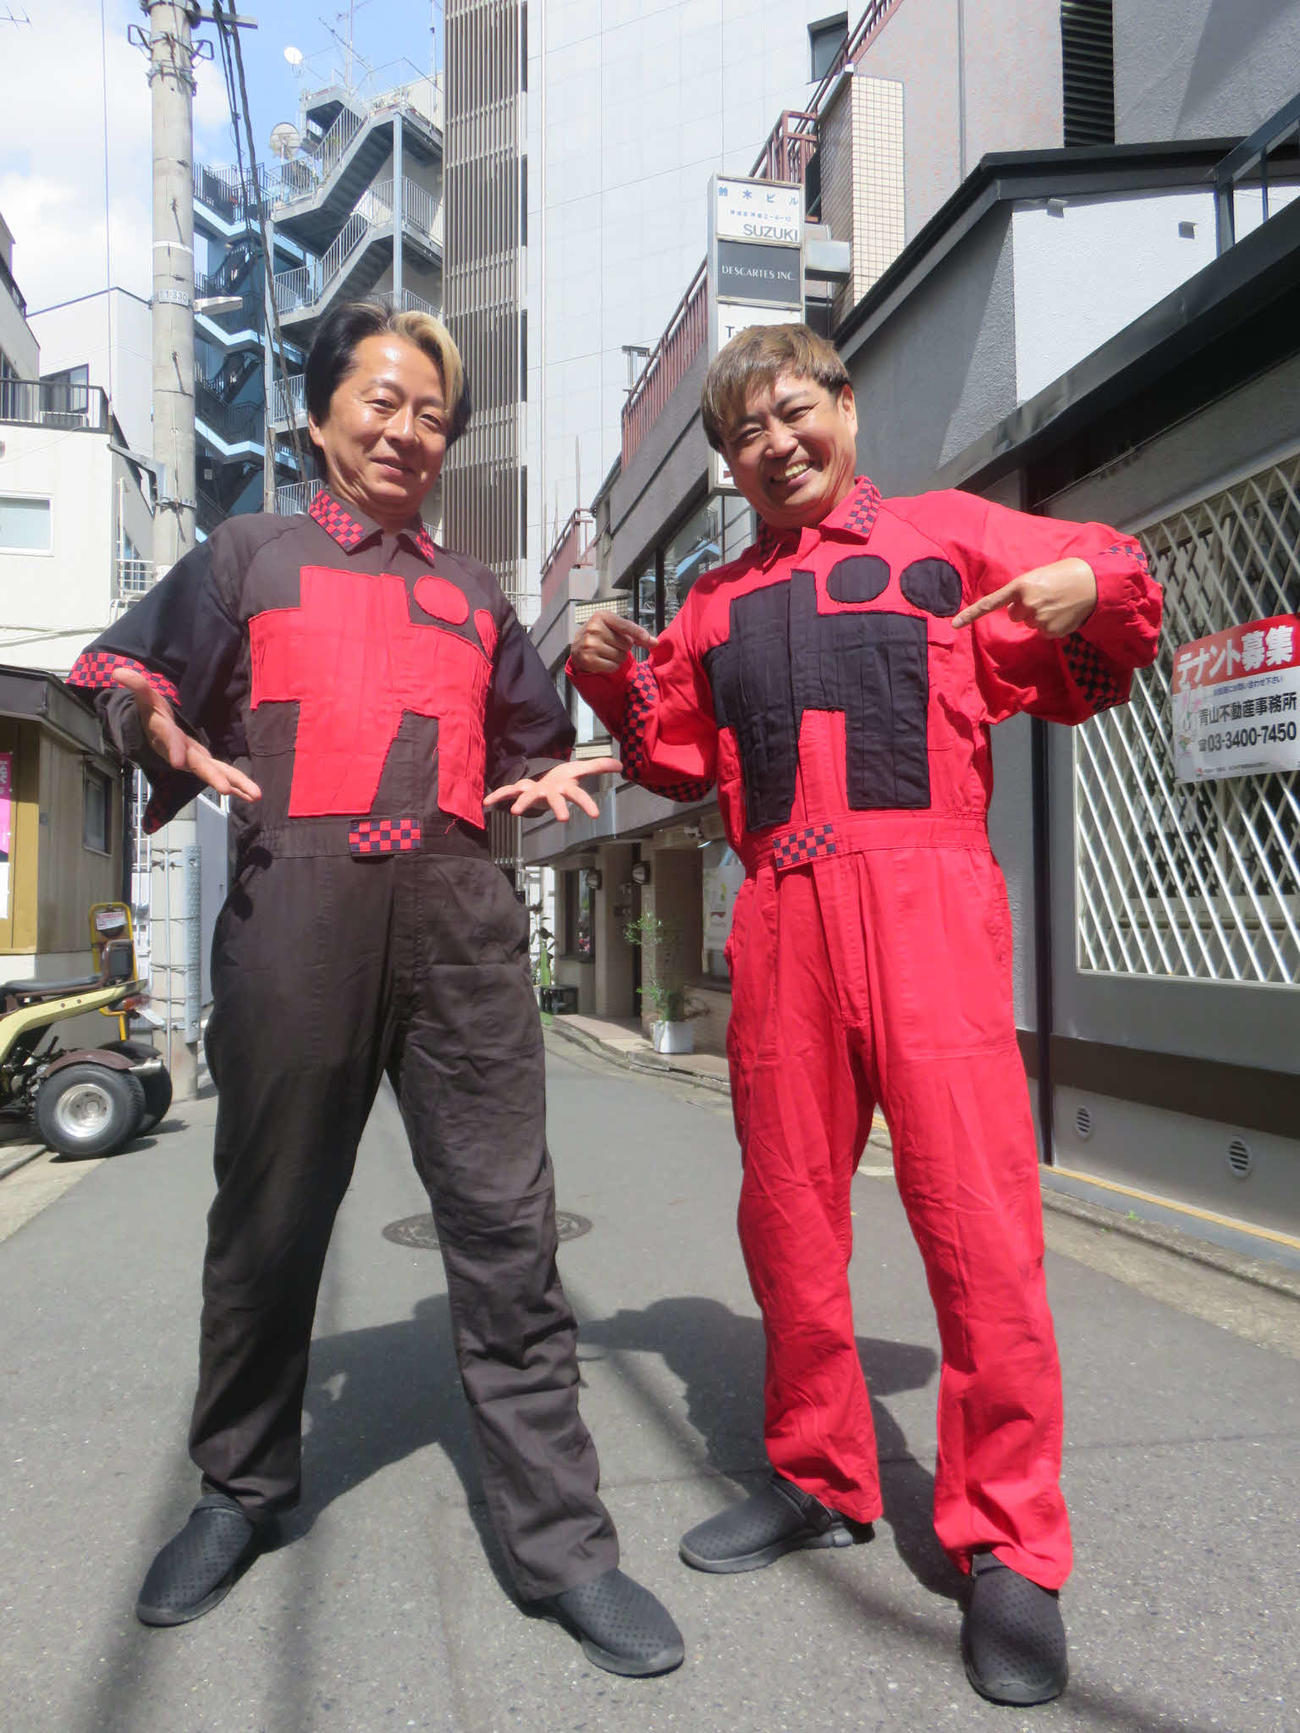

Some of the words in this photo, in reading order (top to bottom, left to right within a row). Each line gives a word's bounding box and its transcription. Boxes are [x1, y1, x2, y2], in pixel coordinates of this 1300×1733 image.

[743, 223, 799, 242] SUZUKI
[721, 264, 775, 280] DESCARTES
[1177, 625, 1294, 684] テナント募集
[1200, 691, 1297, 727] 青山不動産事務所
[1207, 721, 1298, 753] 03-3400-7450
